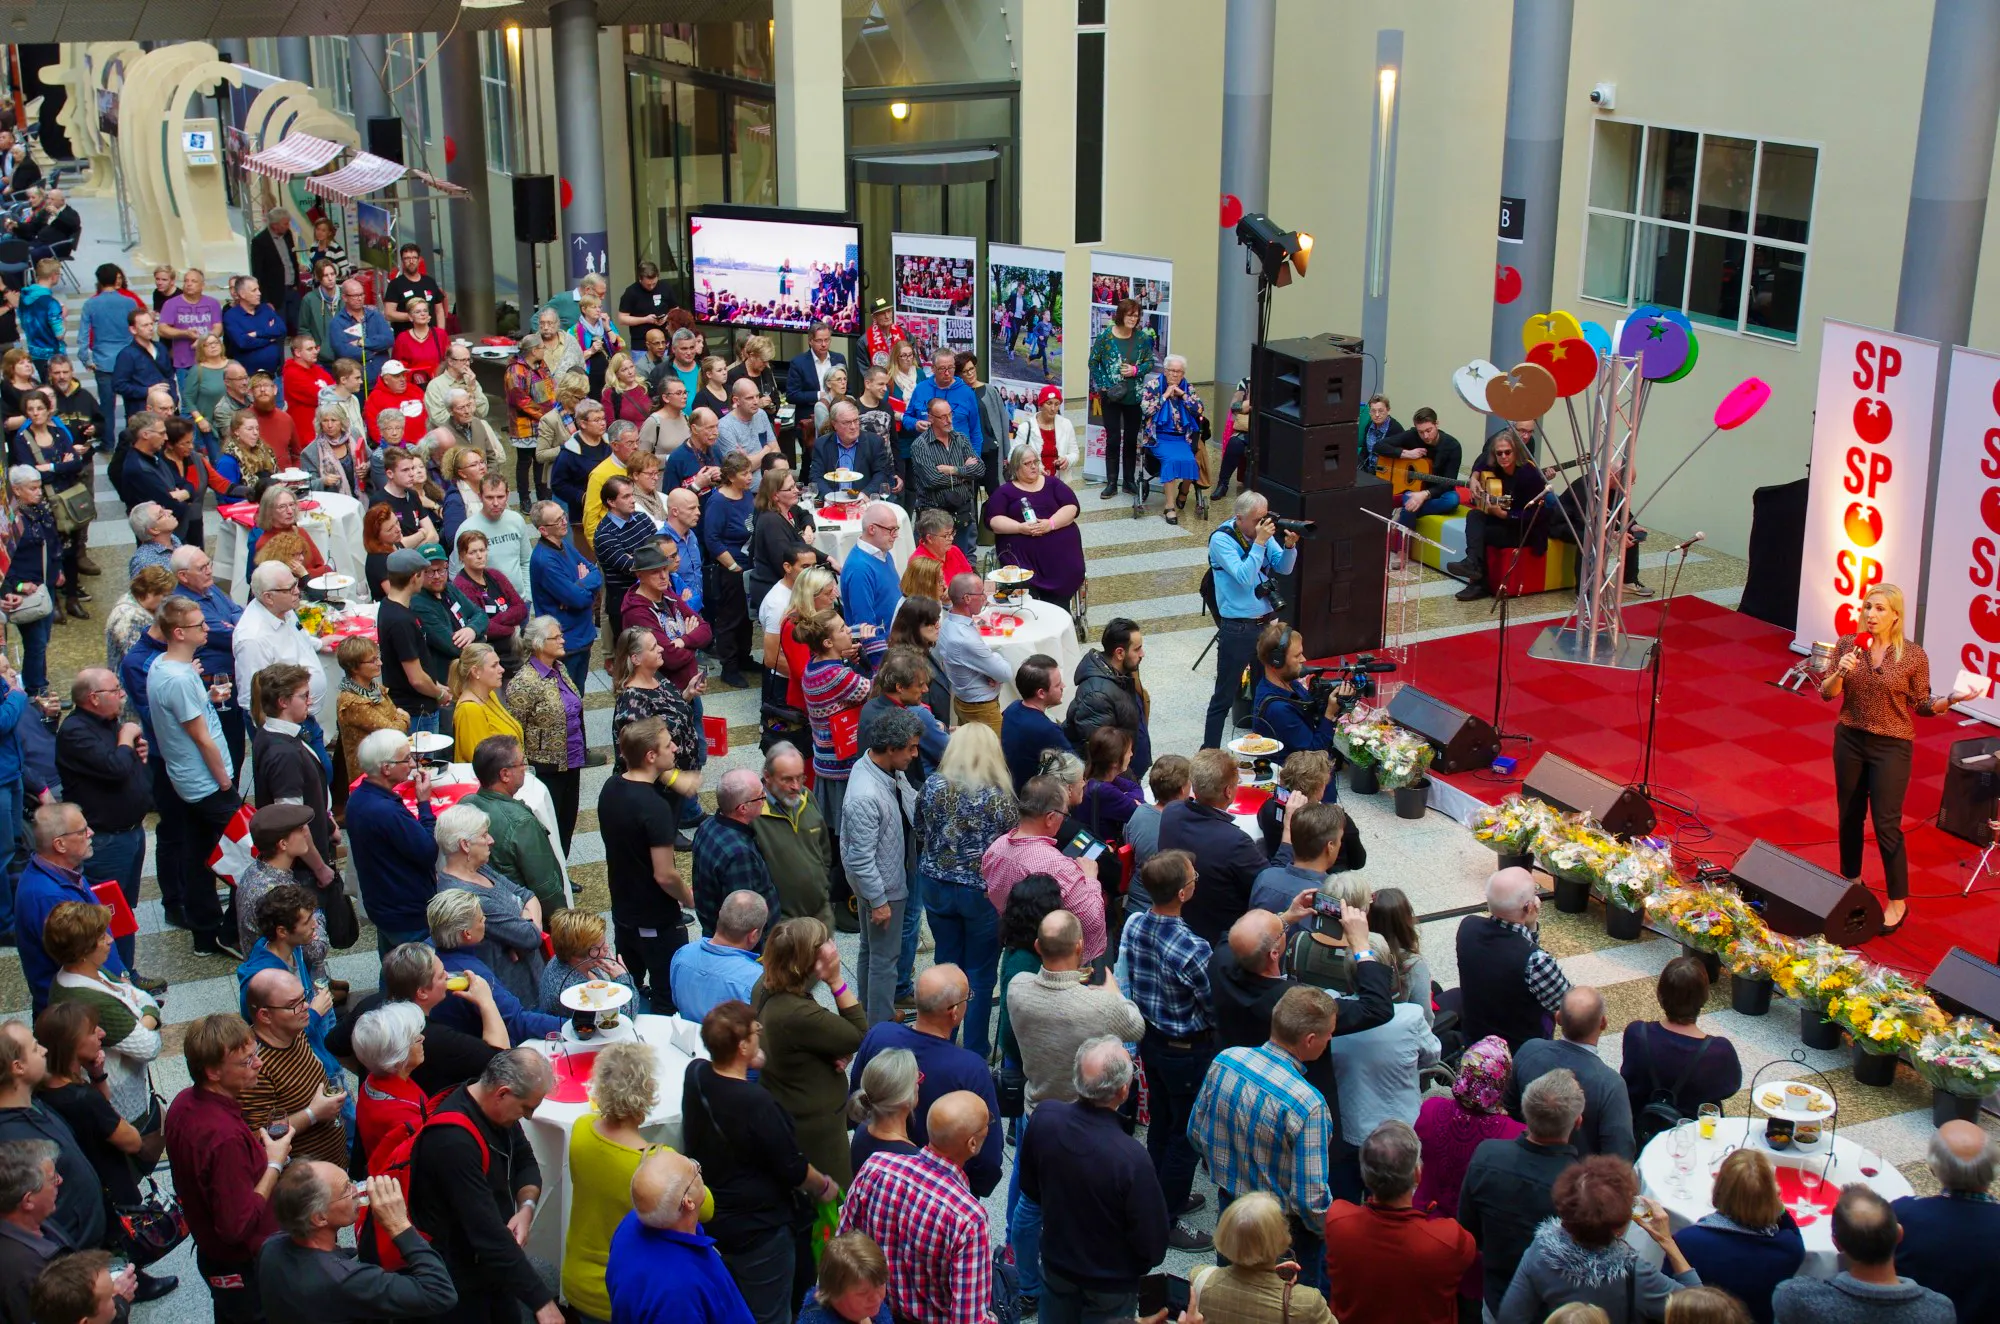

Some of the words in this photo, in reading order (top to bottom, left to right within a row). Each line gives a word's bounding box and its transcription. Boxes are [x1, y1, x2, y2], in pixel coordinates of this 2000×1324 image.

[1501, 209, 1510, 227] B
[178, 314, 211, 323] REPLAY
[947, 319, 972, 329] THUIS
[947, 328, 972, 339] ZORG
[1853, 340, 1902, 394] SP
[1844, 446, 1893, 499] SP
[1981, 428, 2000, 479] S
[1834, 549, 1883, 600] SP
[1969, 537, 2000, 591] S
